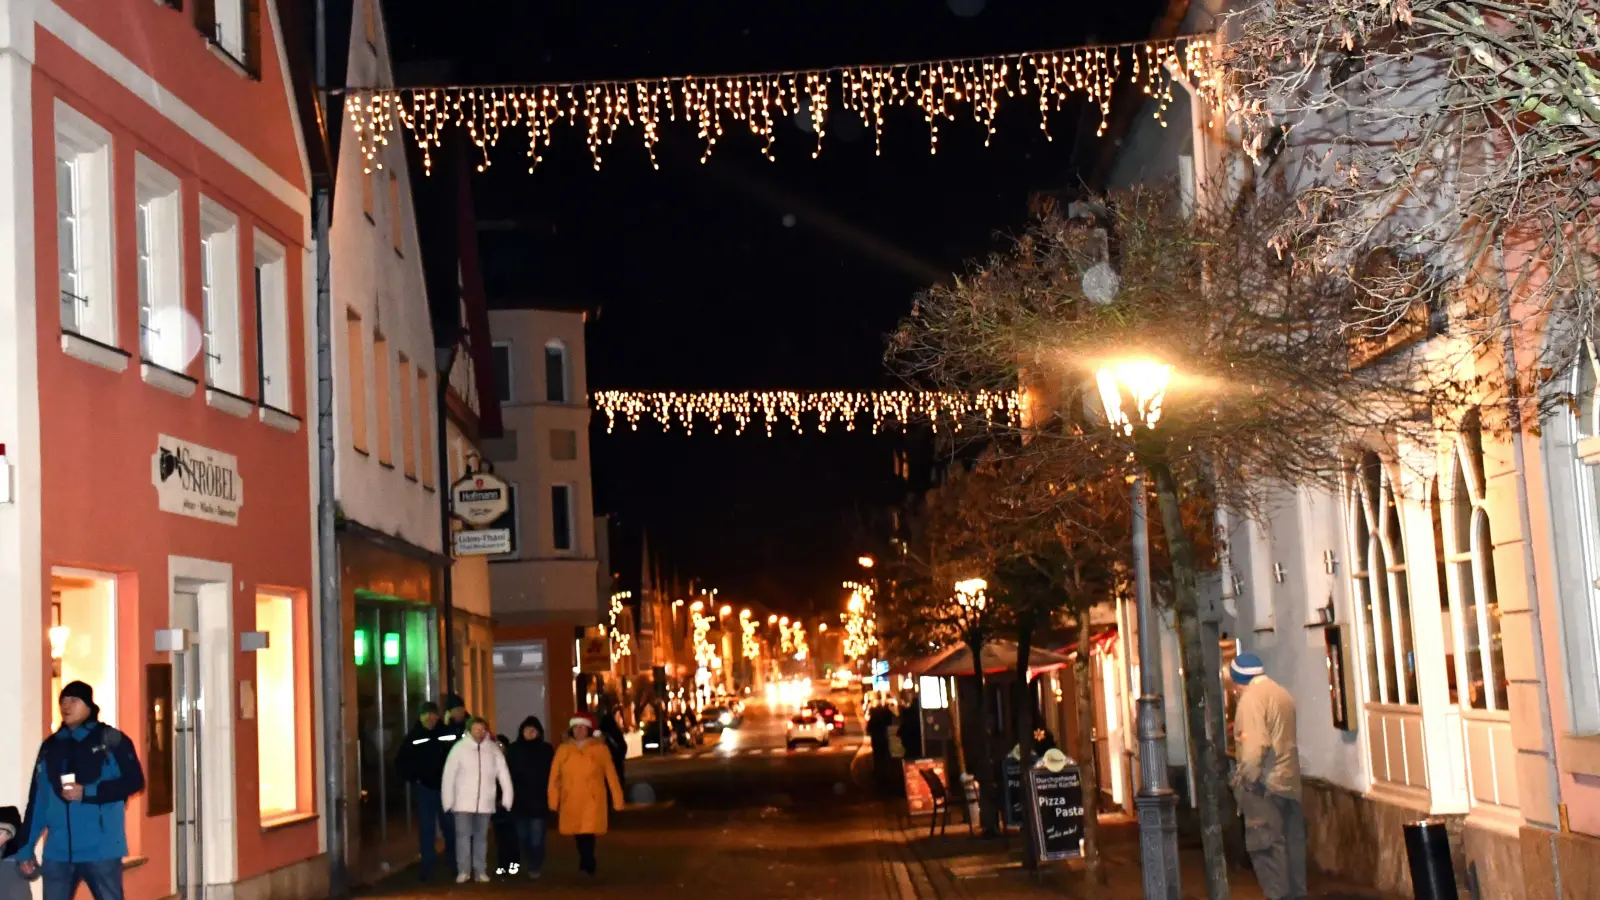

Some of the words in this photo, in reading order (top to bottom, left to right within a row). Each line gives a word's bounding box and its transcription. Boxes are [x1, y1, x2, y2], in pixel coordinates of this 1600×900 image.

[181, 447, 237, 501] STRÖBEL
[462, 491, 498, 501] Hofmann
[1038, 796, 1066, 806] Pizza
[1055, 806, 1084, 817] Pasta
